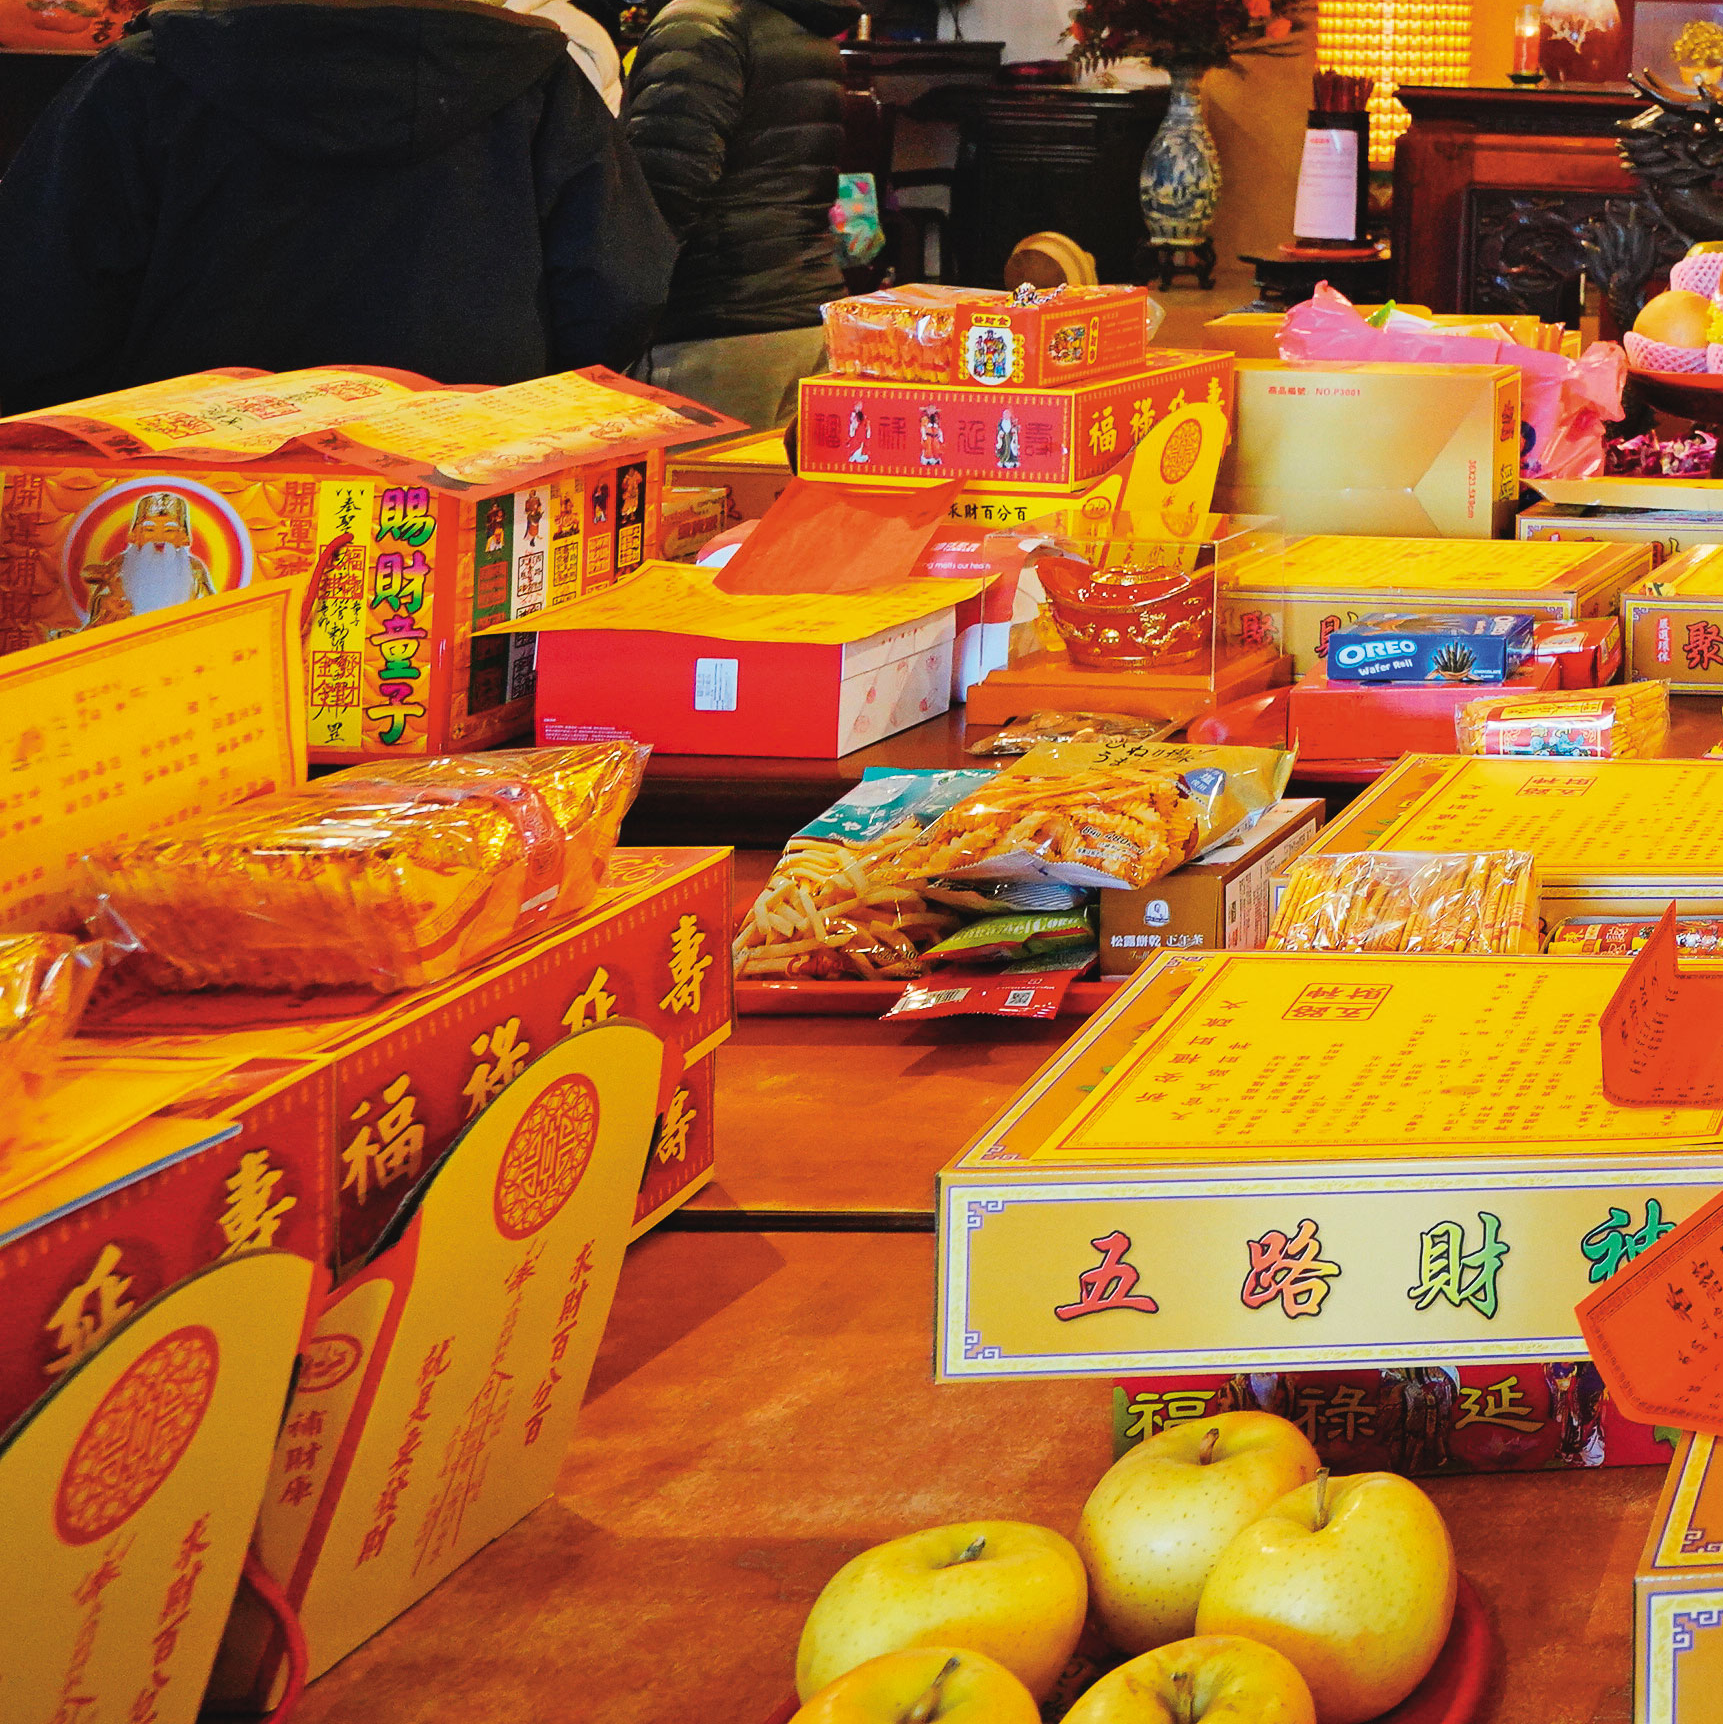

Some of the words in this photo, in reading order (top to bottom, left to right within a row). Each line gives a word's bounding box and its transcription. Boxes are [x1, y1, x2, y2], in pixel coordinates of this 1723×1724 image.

[365, 487, 438, 745] 賜財童子
[1338, 641, 1416, 665] OREO
[1358, 661, 1391, 676] Wafer
[1393, 658, 1413, 671] Roll
[1131, 1000, 1248, 1102] 祈安植財疏文
[1054, 1198, 1682, 1322] 五路財神
